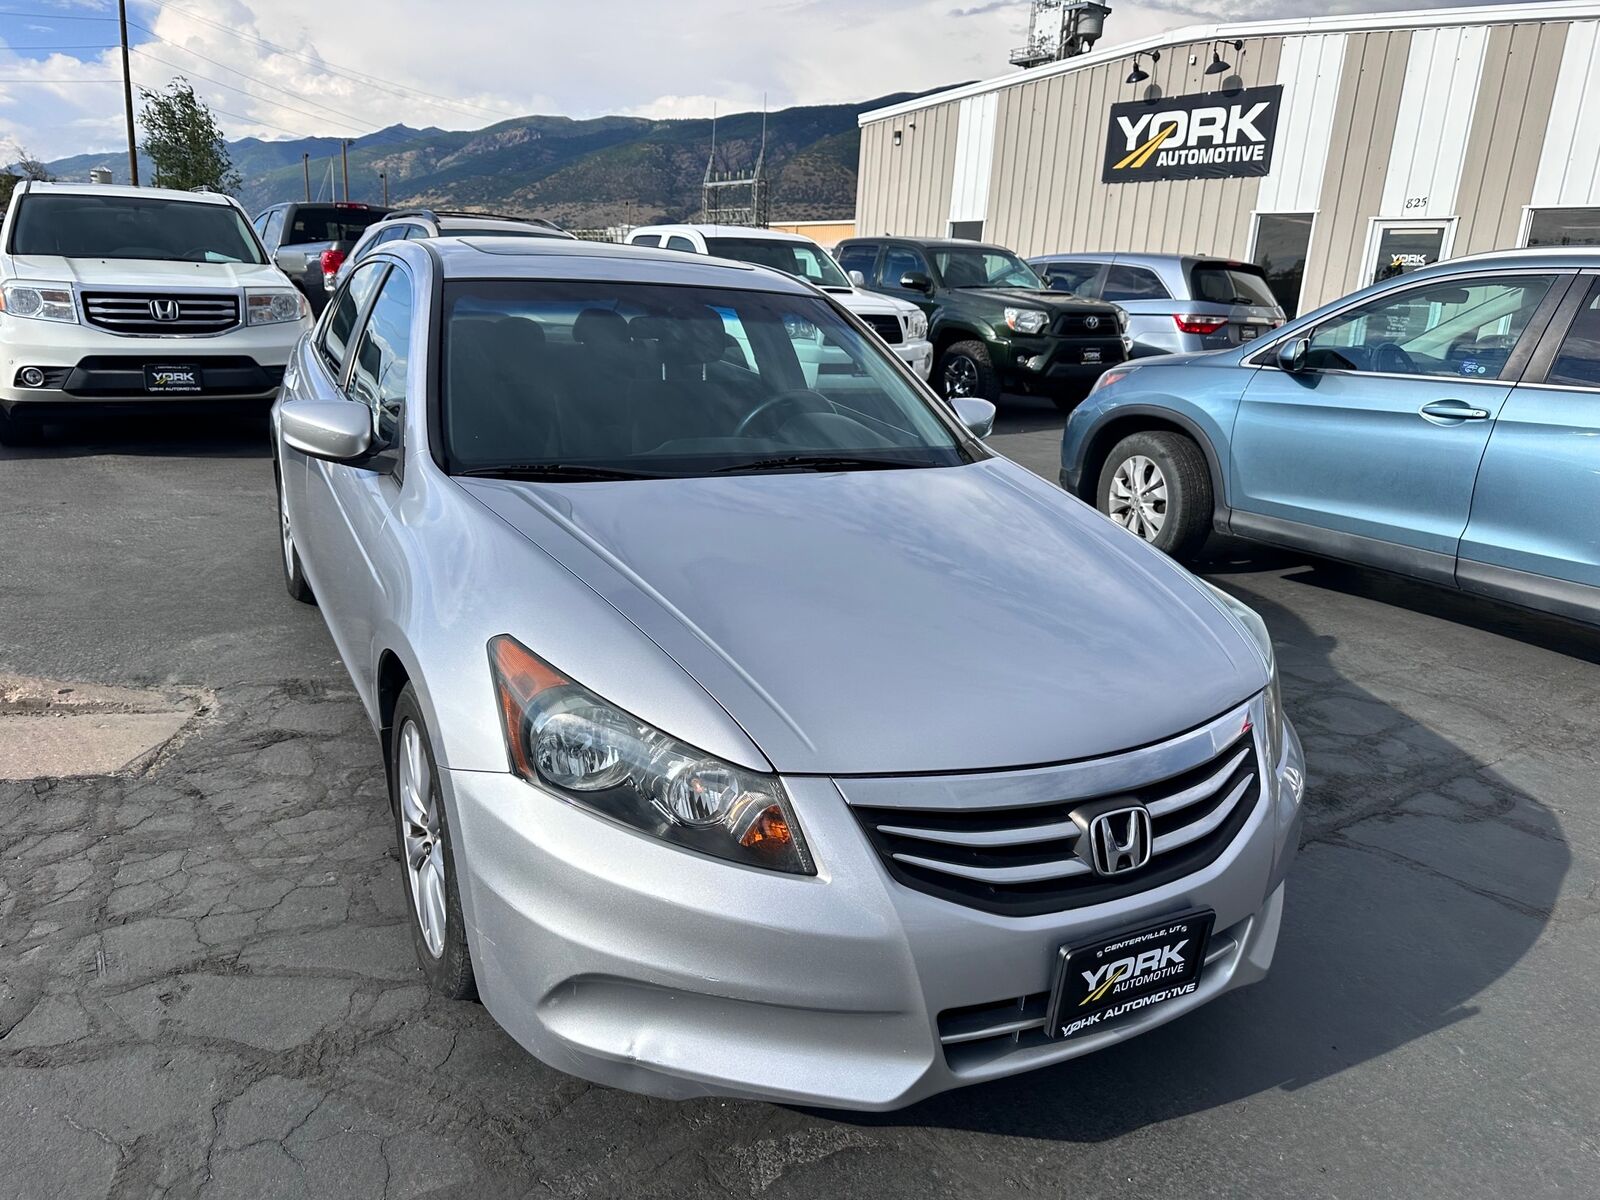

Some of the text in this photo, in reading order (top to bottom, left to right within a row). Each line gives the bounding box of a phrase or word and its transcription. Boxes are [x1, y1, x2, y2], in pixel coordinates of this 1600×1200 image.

[1116, 101, 1271, 152] YORK
[1156, 144, 1265, 167] AUTOMOTIVE
[1405, 197, 1428, 209] 825
[1390, 253, 1427, 265] YORK
[151, 372, 195, 381] YORK
[1104, 924, 1182, 953] CENTERVILLE, UT
[1081, 938, 1190, 992] YORK
[1112, 962, 1185, 994] AUTOMOTIVE
[1102, 982, 1196, 1020] AUTOMOTIVE
